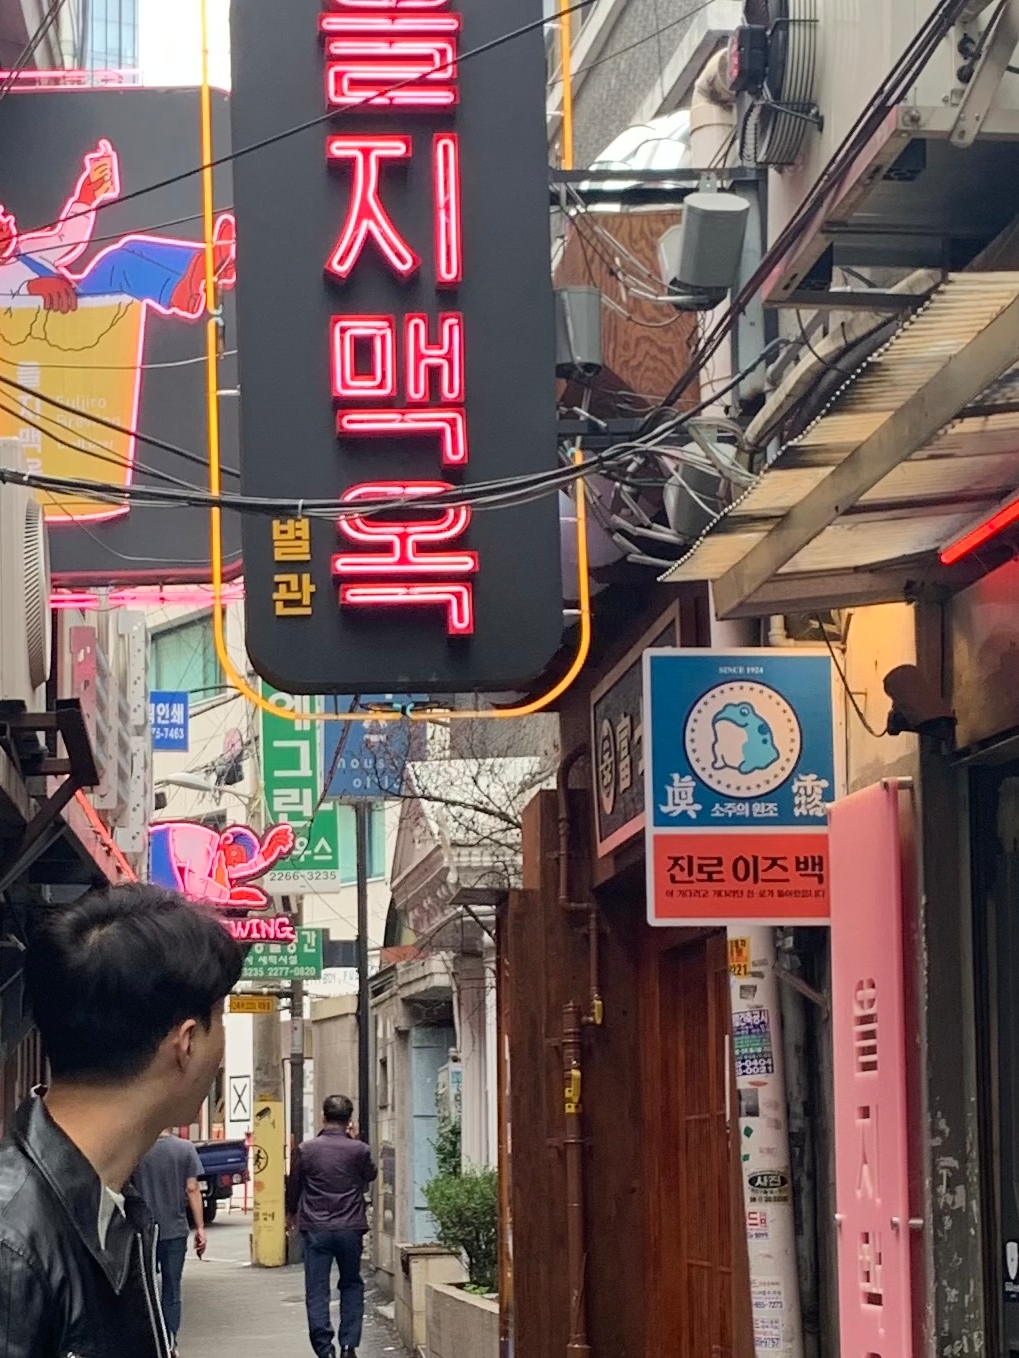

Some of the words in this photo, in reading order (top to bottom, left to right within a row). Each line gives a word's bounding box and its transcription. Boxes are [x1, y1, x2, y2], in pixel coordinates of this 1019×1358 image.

[271, 518, 315, 617] 별관
[711, 803, 750, 818] 소주의
[752, 802, 779, 817] 원조
[269, 870, 337, 882] 2266-3235
[667, 854, 726, 884] 진로
[732, 854, 791, 885] 이즈
[795, 854, 825, 885] 백
